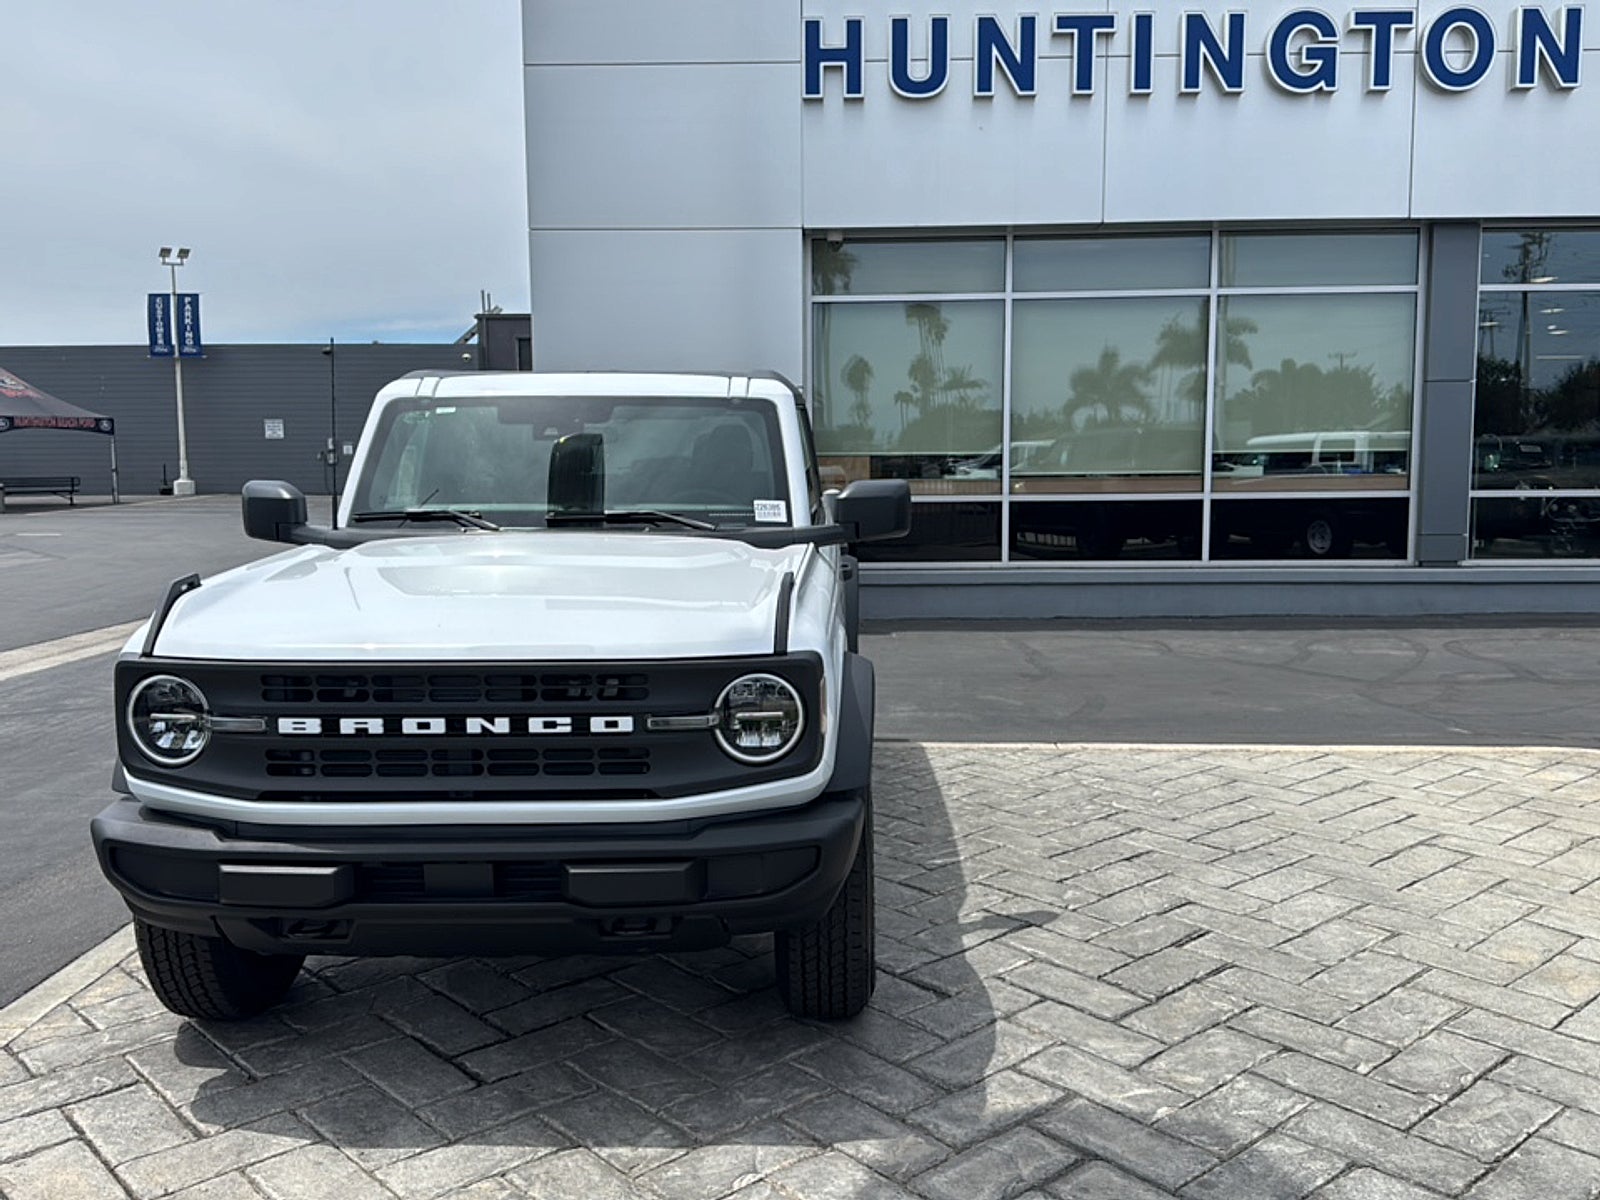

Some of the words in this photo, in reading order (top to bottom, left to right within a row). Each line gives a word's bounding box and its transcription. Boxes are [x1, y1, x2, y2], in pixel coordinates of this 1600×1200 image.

[803, 8, 1583, 99] HUNTINGTON
[155, 296, 164, 345] CUSTOMER
[184, 296, 194, 345] PARKING
[277, 716, 635, 735] BRONCO
